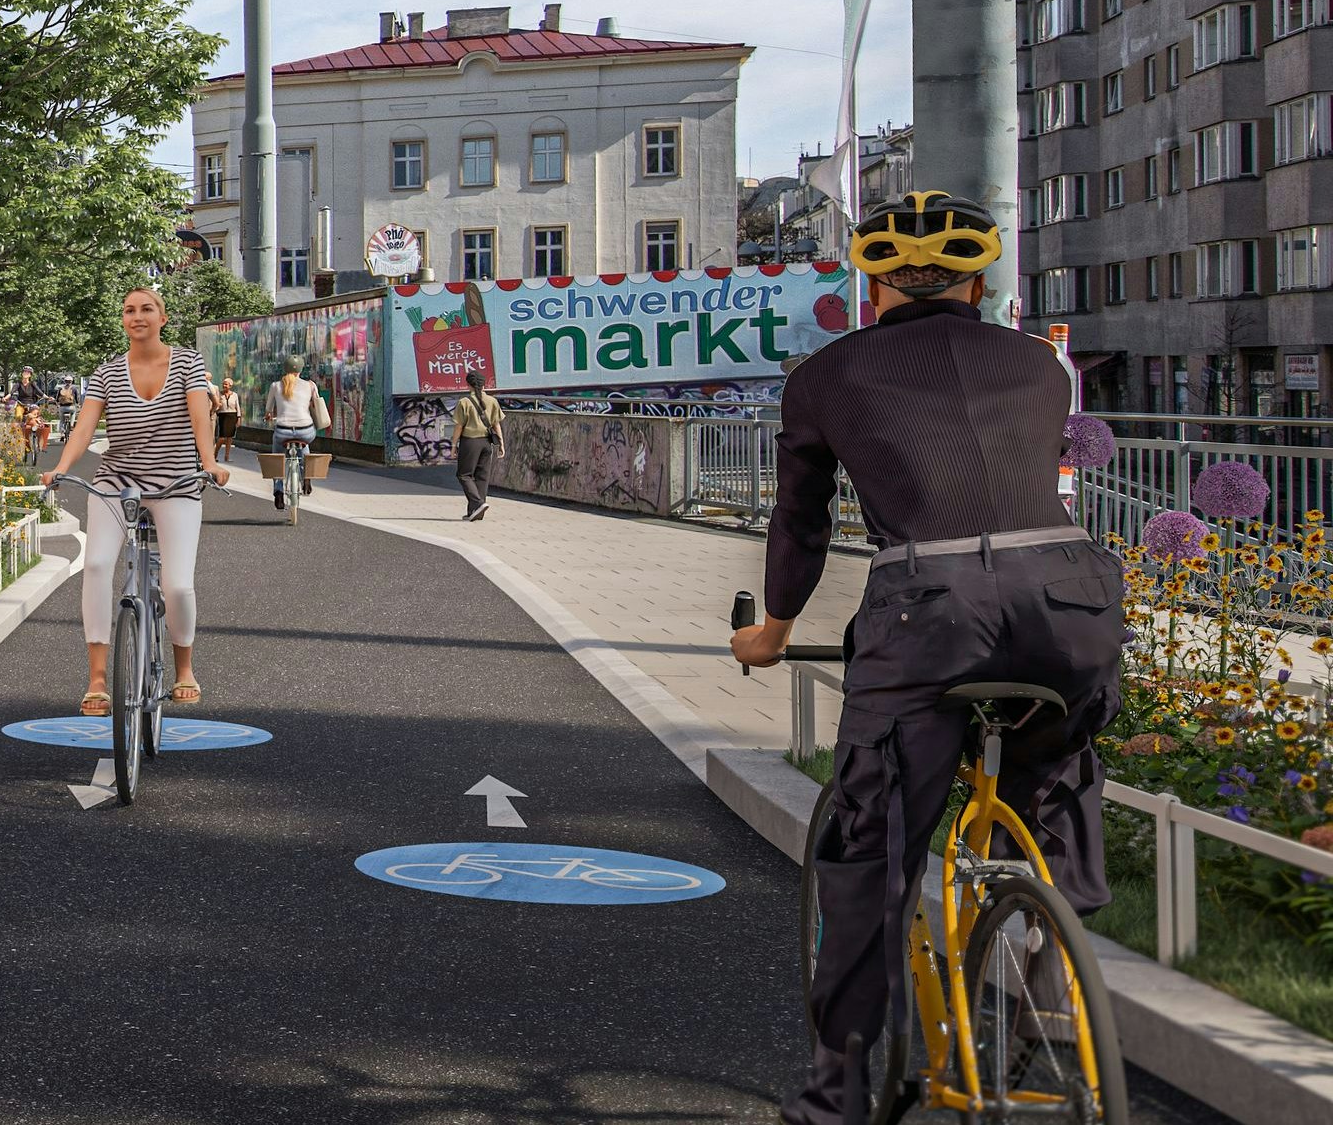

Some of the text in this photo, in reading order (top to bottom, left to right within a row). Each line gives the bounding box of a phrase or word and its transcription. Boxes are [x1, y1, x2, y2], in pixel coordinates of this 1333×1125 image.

[509, 276, 783, 321] schwender
[448, 341, 463, 351] Es
[512, 308, 789, 374] markt
[435, 350, 477, 360] werde
[428, 356, 486, 374] Markt
